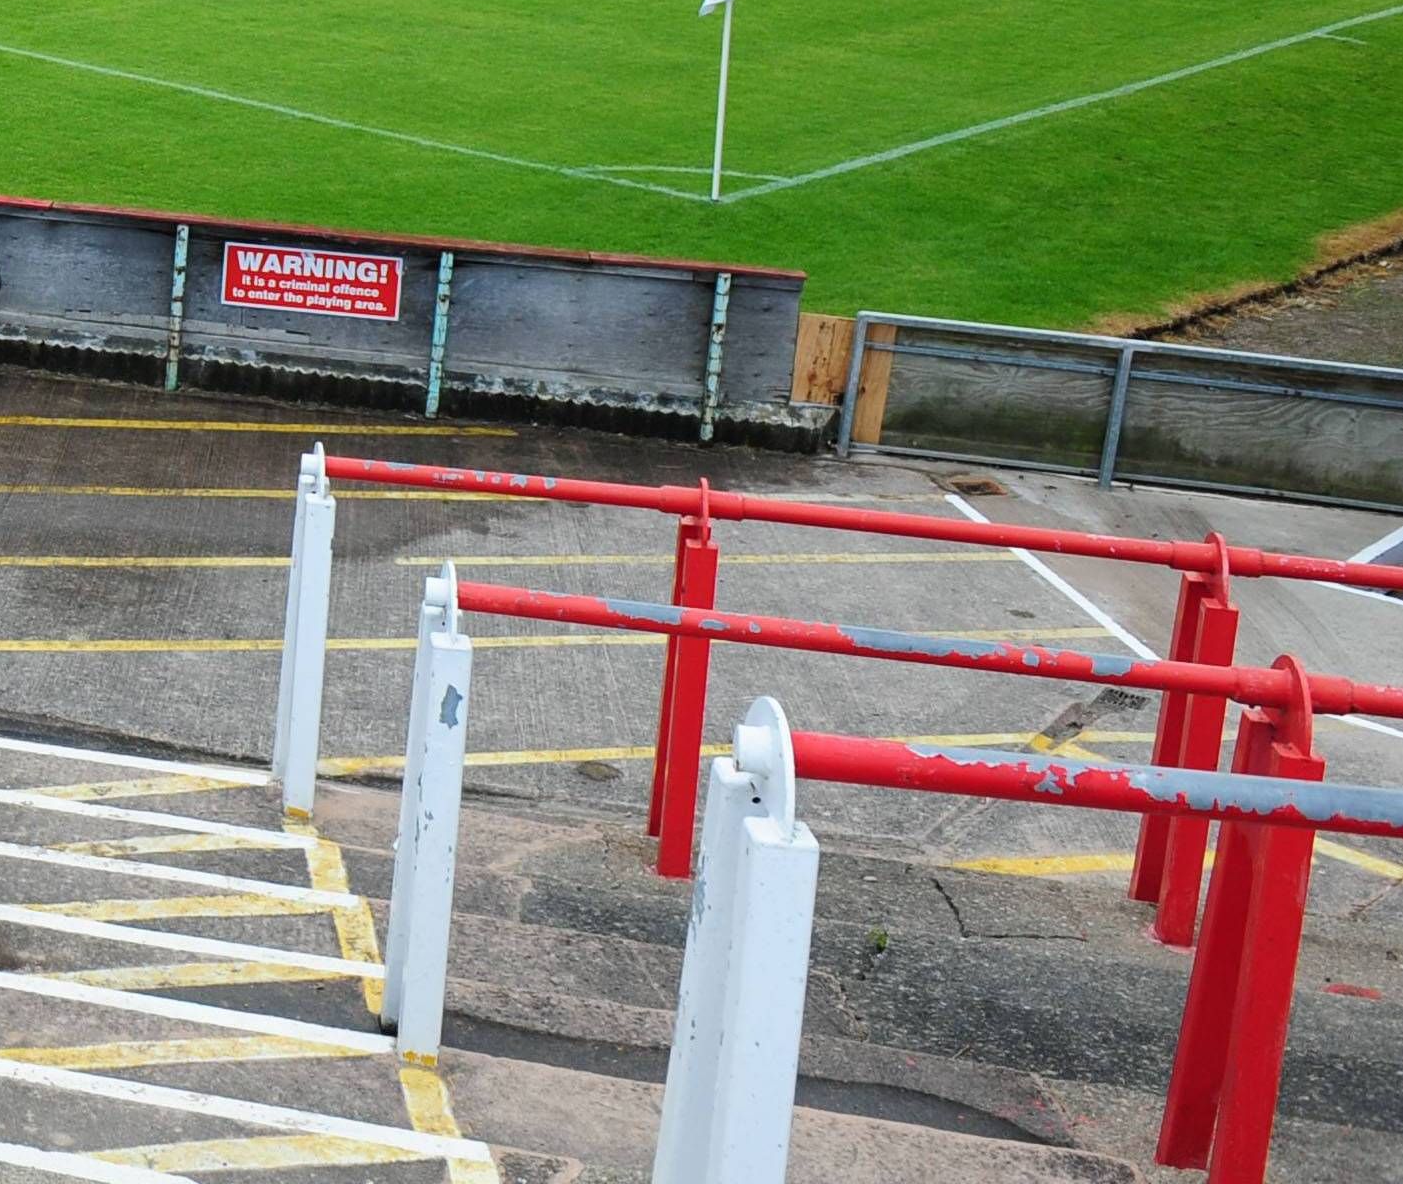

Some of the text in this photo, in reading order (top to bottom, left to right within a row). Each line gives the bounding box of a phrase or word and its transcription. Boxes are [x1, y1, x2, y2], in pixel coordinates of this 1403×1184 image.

[236, 250, 389, 284] WARNING!
[242, 274, 380, 298] It is a criminal offence
[232, 287, 388, 312] to enter the playing area.
